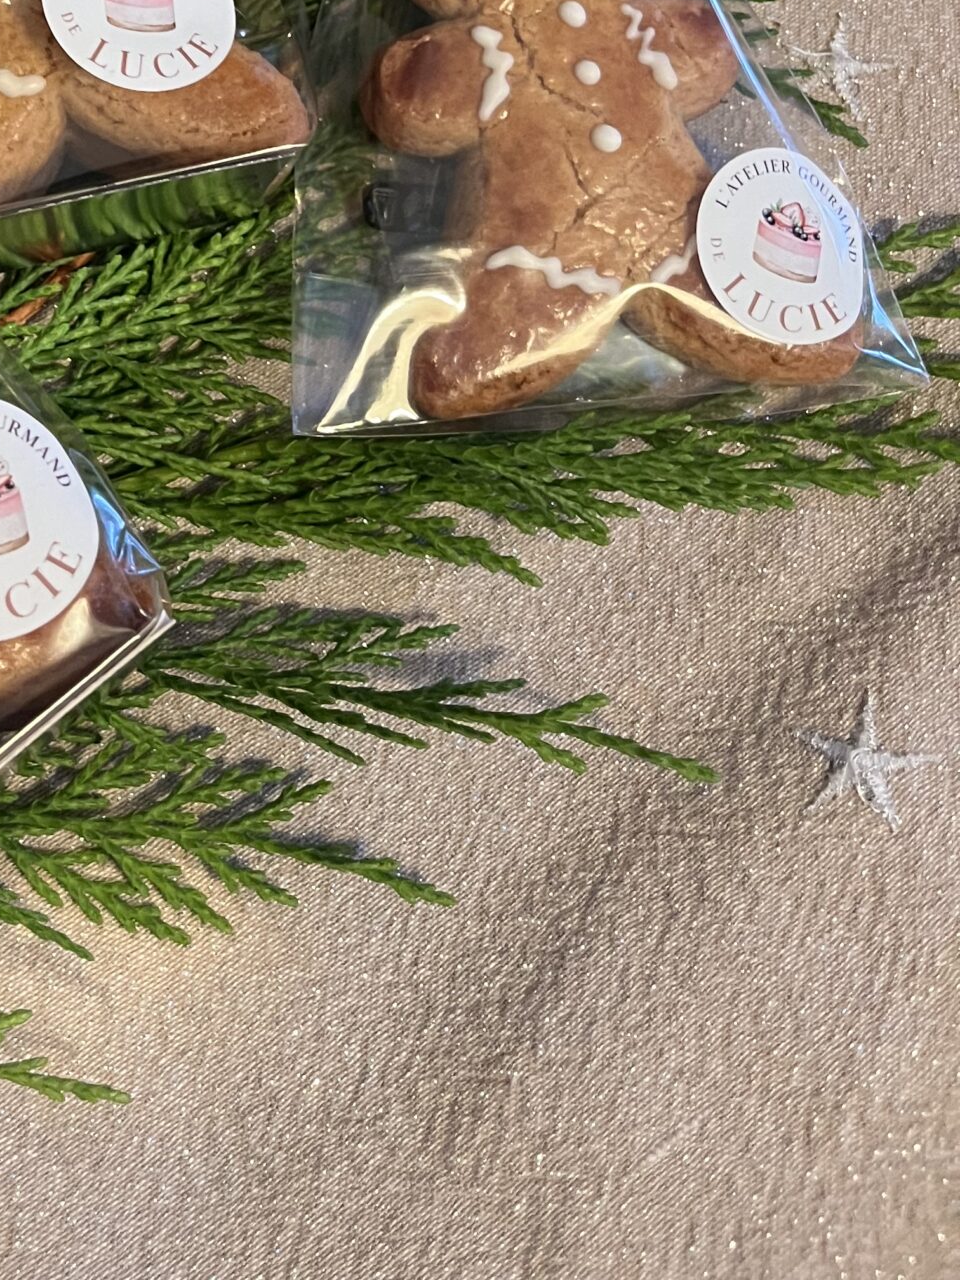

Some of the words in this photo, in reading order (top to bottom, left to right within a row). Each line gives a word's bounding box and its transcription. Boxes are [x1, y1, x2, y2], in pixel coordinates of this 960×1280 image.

[60, 11, 82, 36] DE
[88, 32, 219, 79] LUCIE
[715, 158, 790, 209] L'ATELIER
[798, 165, 858, 263] GOURMAND
[710, 237, 726, 263] DE
[723, 273, 848, 333] LUCIE
